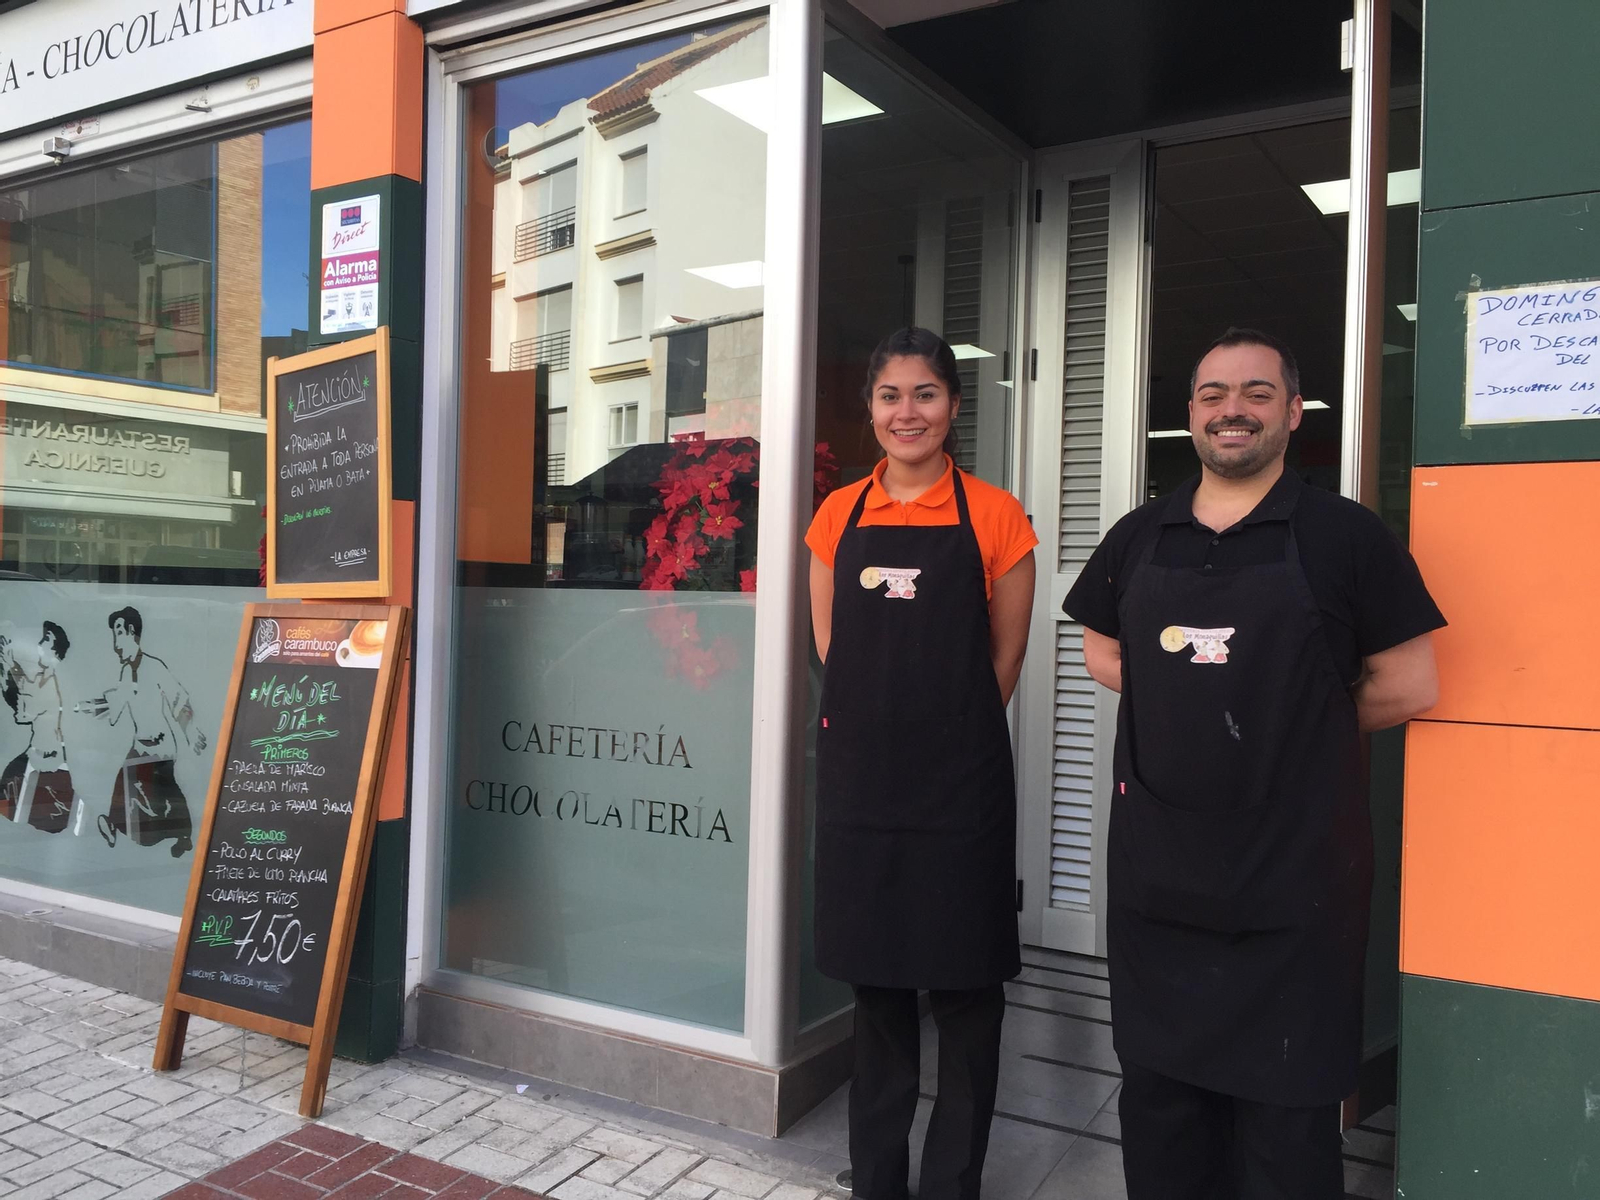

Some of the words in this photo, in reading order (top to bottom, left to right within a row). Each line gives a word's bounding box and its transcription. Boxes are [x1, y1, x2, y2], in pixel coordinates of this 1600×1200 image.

[43, 0, 294, 80] CHOCOLATER
[324, 259, 378, 279] Alarma
[323, 279, 335, 287] con
[335, 275, 351, 285] Aviso
[357, 273, 377, 282] Policía
[1517, 309, 1600, 327] CERRAD
[1479, 337, 1521, 354] POR
[1556, 354, 1591, 366] DEL
[1569, 382, 1595, 392] LAS
[336, 426, 347, 441] LA
[280, 459, 318, 480] ENTRADA
[322, 457, 329, 470] A
[331, 450, 352, 467] TODA
[291, 483, 304, 498] EN
[336, 474, 343, 488] O
[345, 468, 366, 486] BATA
[286, 625, 312, 639] cafés
[284, 637, 338, 652] carambuco
[306, 681, 341, 707] DEL
[502, 720, 693, 769] CAFETERÍA
[269, 763, 282, 774] DE
[270, 800, 282, 812] DE
[250, 848, 264, 860] AL
[266, 846, 303, 865] CURRY
[248, 867, 261, 879] DE
